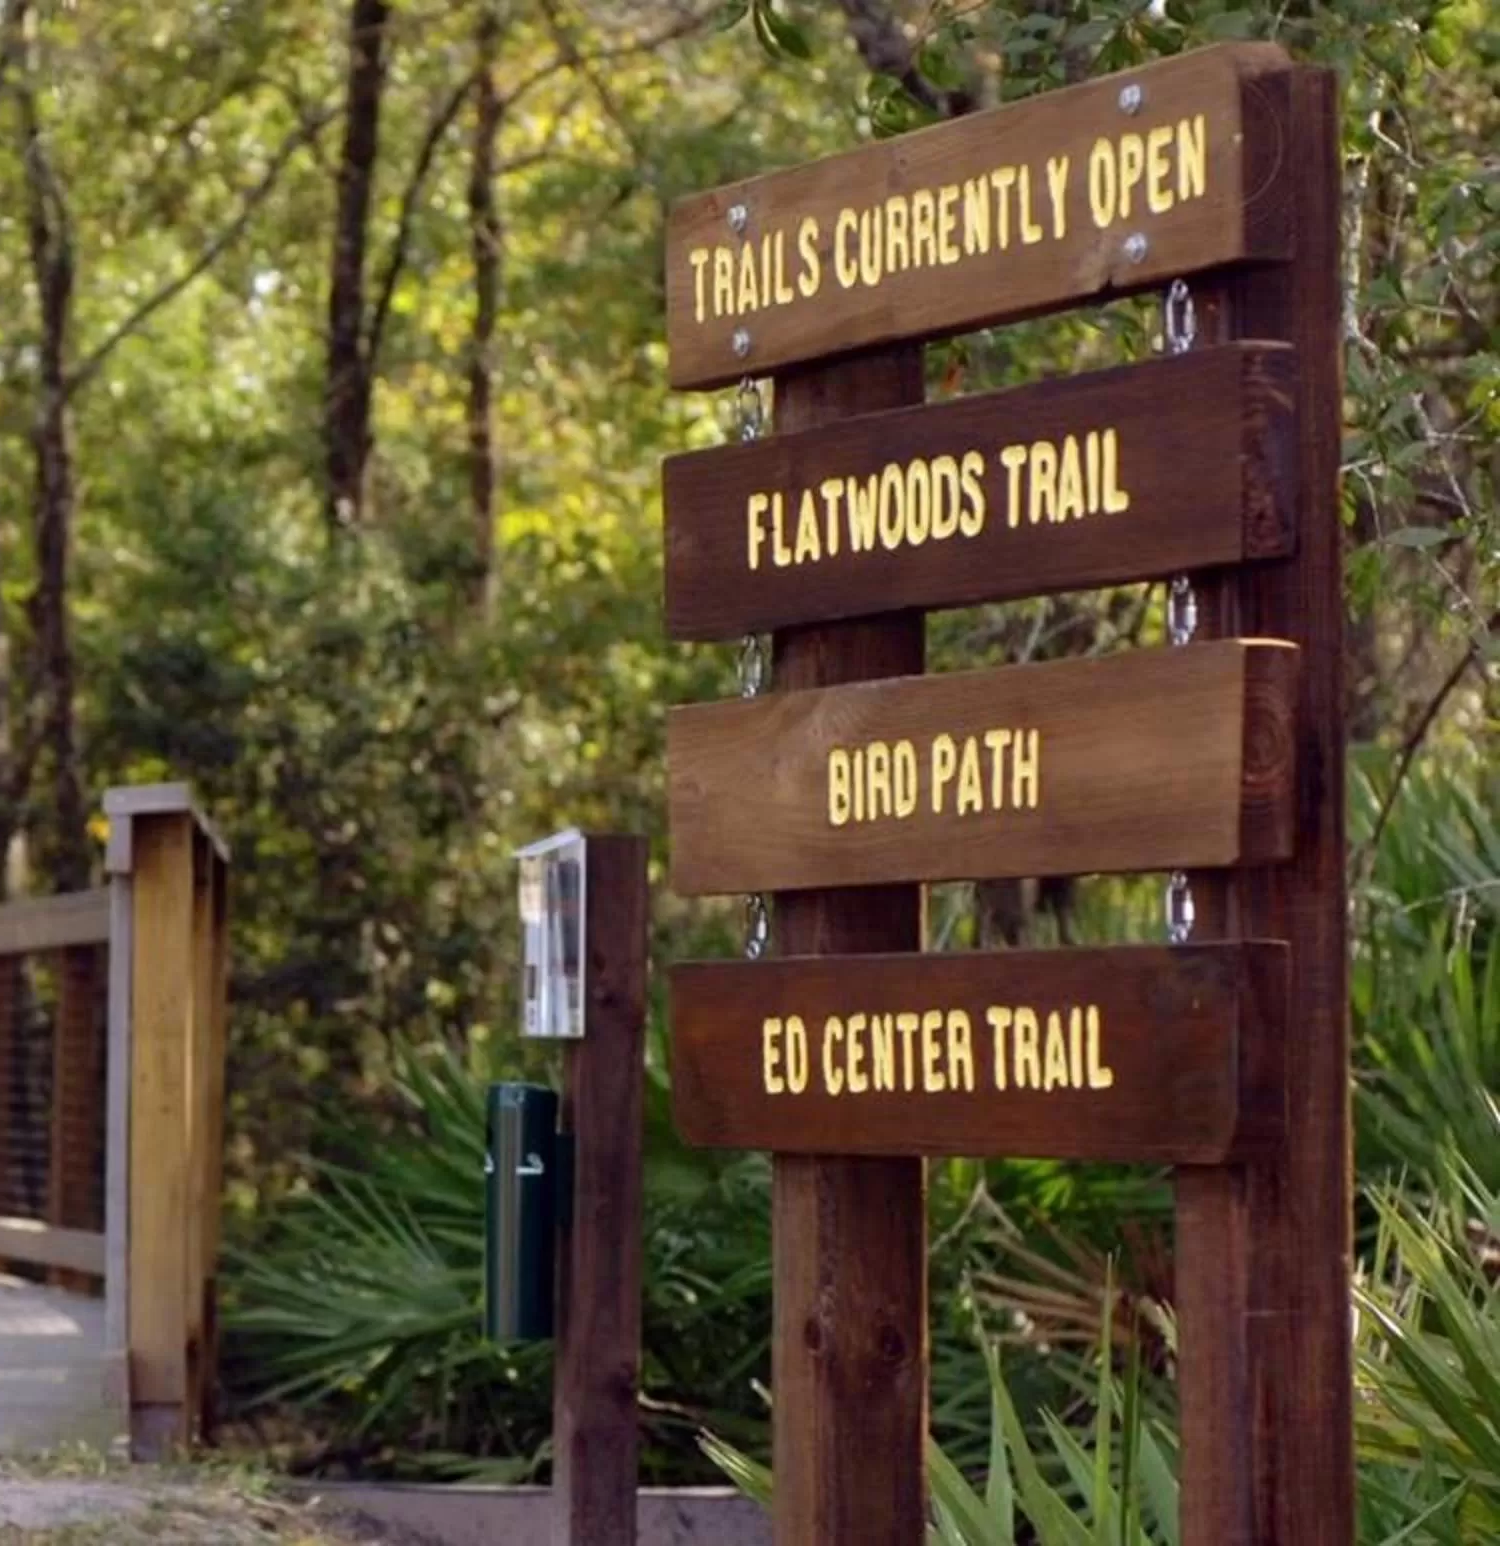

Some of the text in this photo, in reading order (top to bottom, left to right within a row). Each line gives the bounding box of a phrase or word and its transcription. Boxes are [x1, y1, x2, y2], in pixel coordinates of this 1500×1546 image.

[688, 114, 1206, 324] TRAILS CURRENTLY OPEN
[747, 429, 1129, 570] FLATWOODS TRAIL
[828, 729, 1040, 827] BIRD PATH
[762, 1005, 1114, 1096] ED CENTER TRAIL
